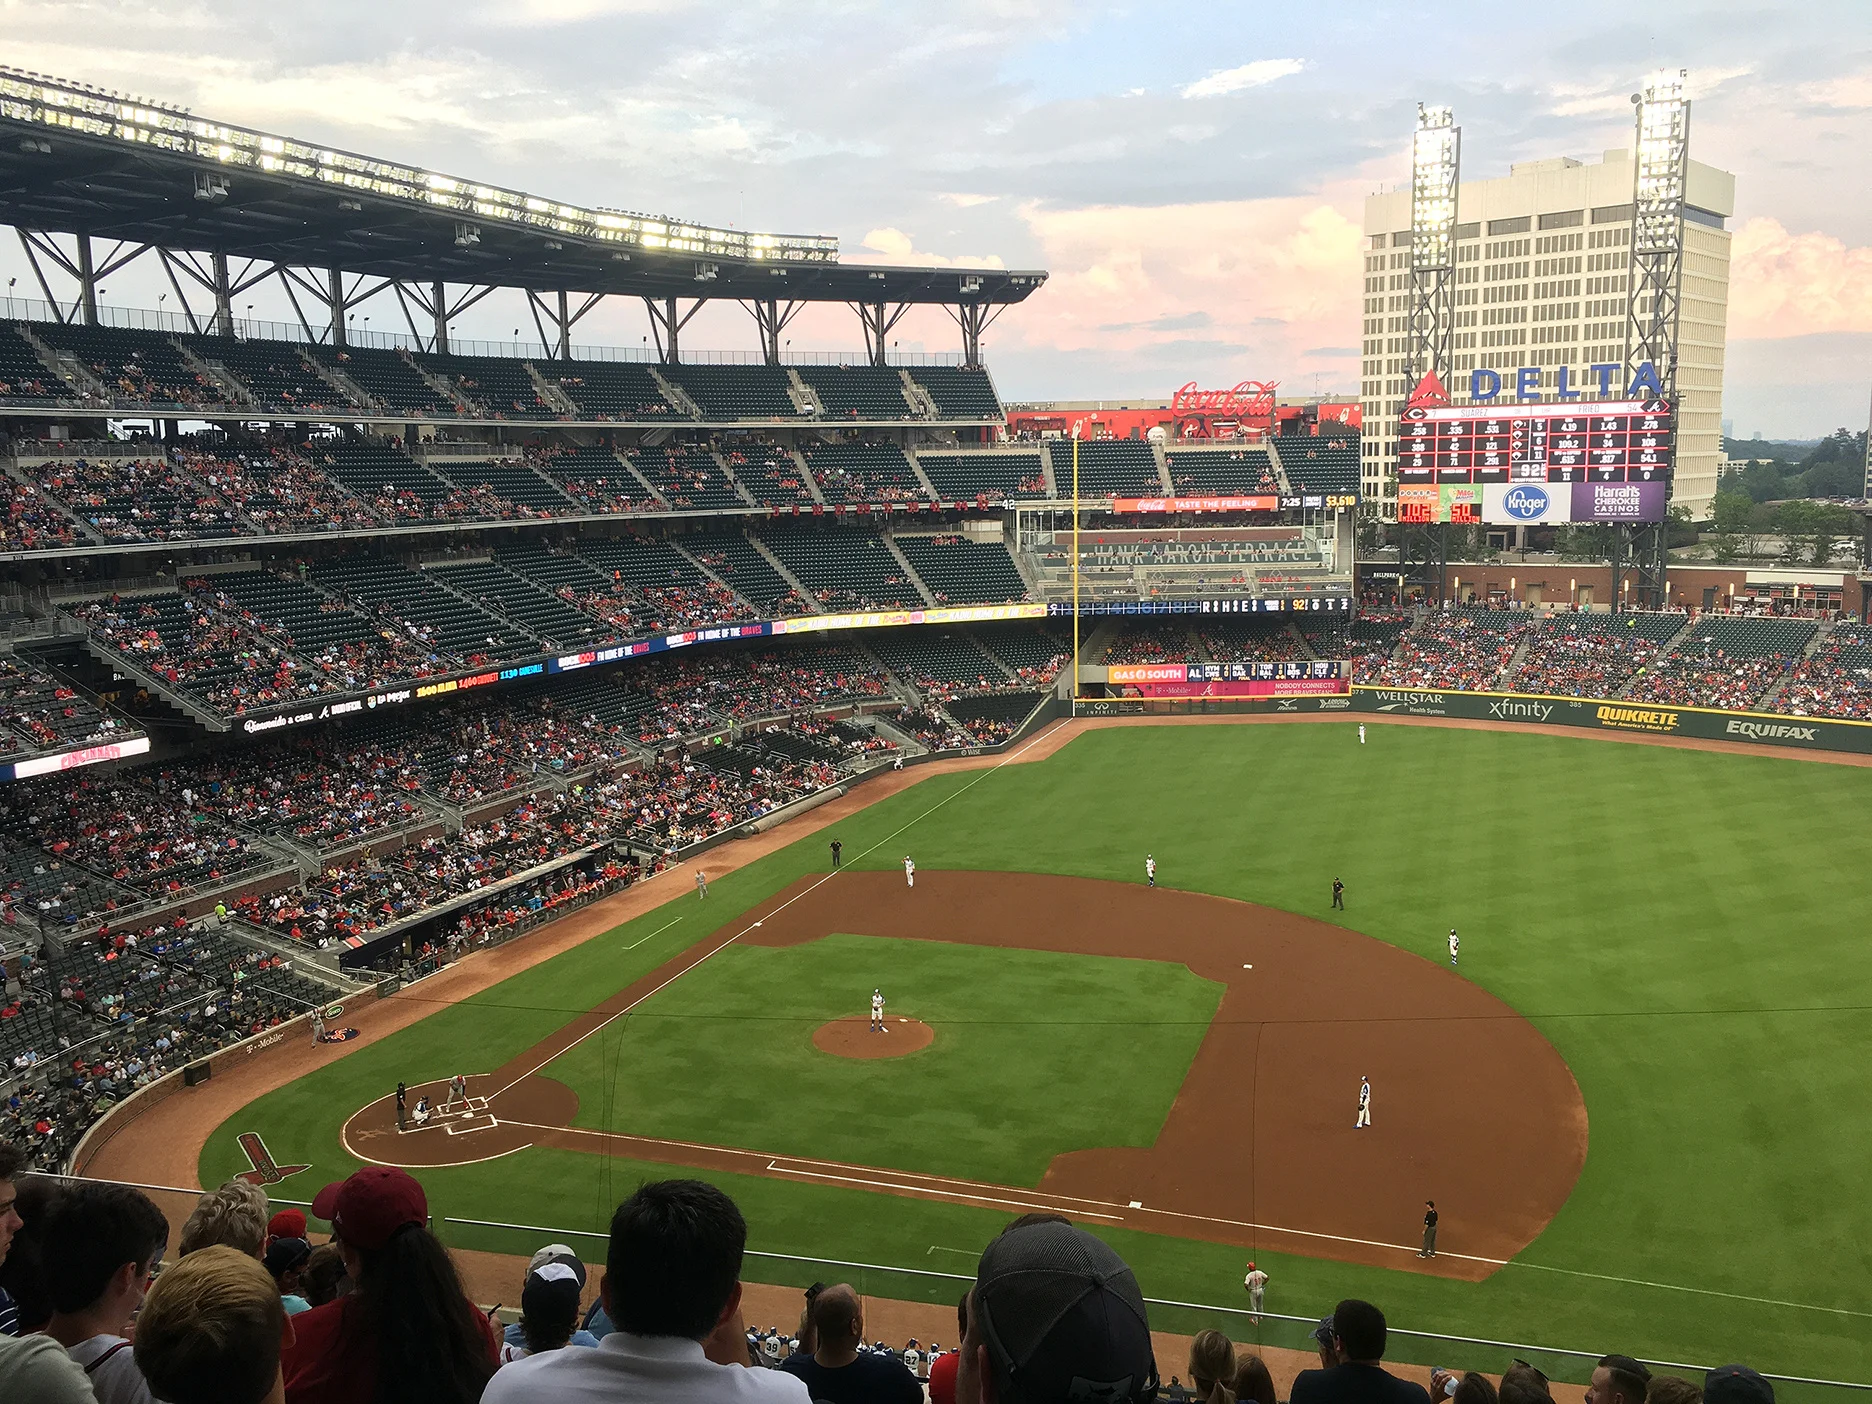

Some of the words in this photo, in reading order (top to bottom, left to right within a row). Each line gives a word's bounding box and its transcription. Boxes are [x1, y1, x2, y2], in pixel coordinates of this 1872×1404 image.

[1471, 362, 1663, 400] DELTA
[1460, 408, 1488, 418] SUAREZ
[1578, 404, 1600, 413] FRIED
[1627, 403, 1637, 412] 54
[1449, 442, 1460, 451] 42
[1602, 439, 1613, 448] 34
[1520, 464, 1541, 477] 92
[1562, 472, 1571, 481] 11
[1594, 485, 1641, 498] Harrah's
[1001, 499, 1015, 510] 42
[1221, 499, 1258, 508] FEELING
[1281, 497, 1301, 507] 7:25
[1326, 495, 1356, 508] $3,610
[1508, 490, 1546, 516] Kroger
[1407, 503, 1430, 516] 102
[1452, 503, 1471, 516] 50
[1094, 545, 1144, 565] HANK
[1152, 543, 1216, 564] AARON
[1220, 541, 1312, 563] TERRACE
[1080, 602, 1090, 615] 2
[1095, 602, 1106, 615] 3
[1110, 602, 1121, 614] 4
[1125, 602, 1136, 614] 5
[1141, 602, 1152, 614] 6
[1157, 601, 1168, 614] 7
[1173, 601, 1183, 613] 8
[1187, 601, 1198, 613] 9
[1202, 601, 1210, 612] R
[1222, 601, 1230, 612] H
[1242, 600, 1248, 612] E
[1292, 599, 1305, 610] 92
[741, 625, 762, 636] BRAVES
[500, 668, 518, 680] 1130
[1113, 671, 1135, 680] GAS
[1147, 669, 1182, 679] SOUTH
[1188, 668, 1202, 678] AL
[458, 676, 478, 689] 1460
[386, 689, 411, 704] Mejor
[1375, 690, 1443, 704] WELLSTAR
[1427, 707, 1445, 715] System
[1488, 698, 1554, 721] xfinity
[244, 715, 287, 734] Bienvenido
[294, 712, 314, 722] casa
[1596, 706, 1679, 727] QUIKRETE
[1725, 720, 1816, 741] EQUIFAX
[60, 745, 121, 770] CINCINNATI
[766, 1342, 778, 1353] 39
[905, 1355, 917, 1365] 27
